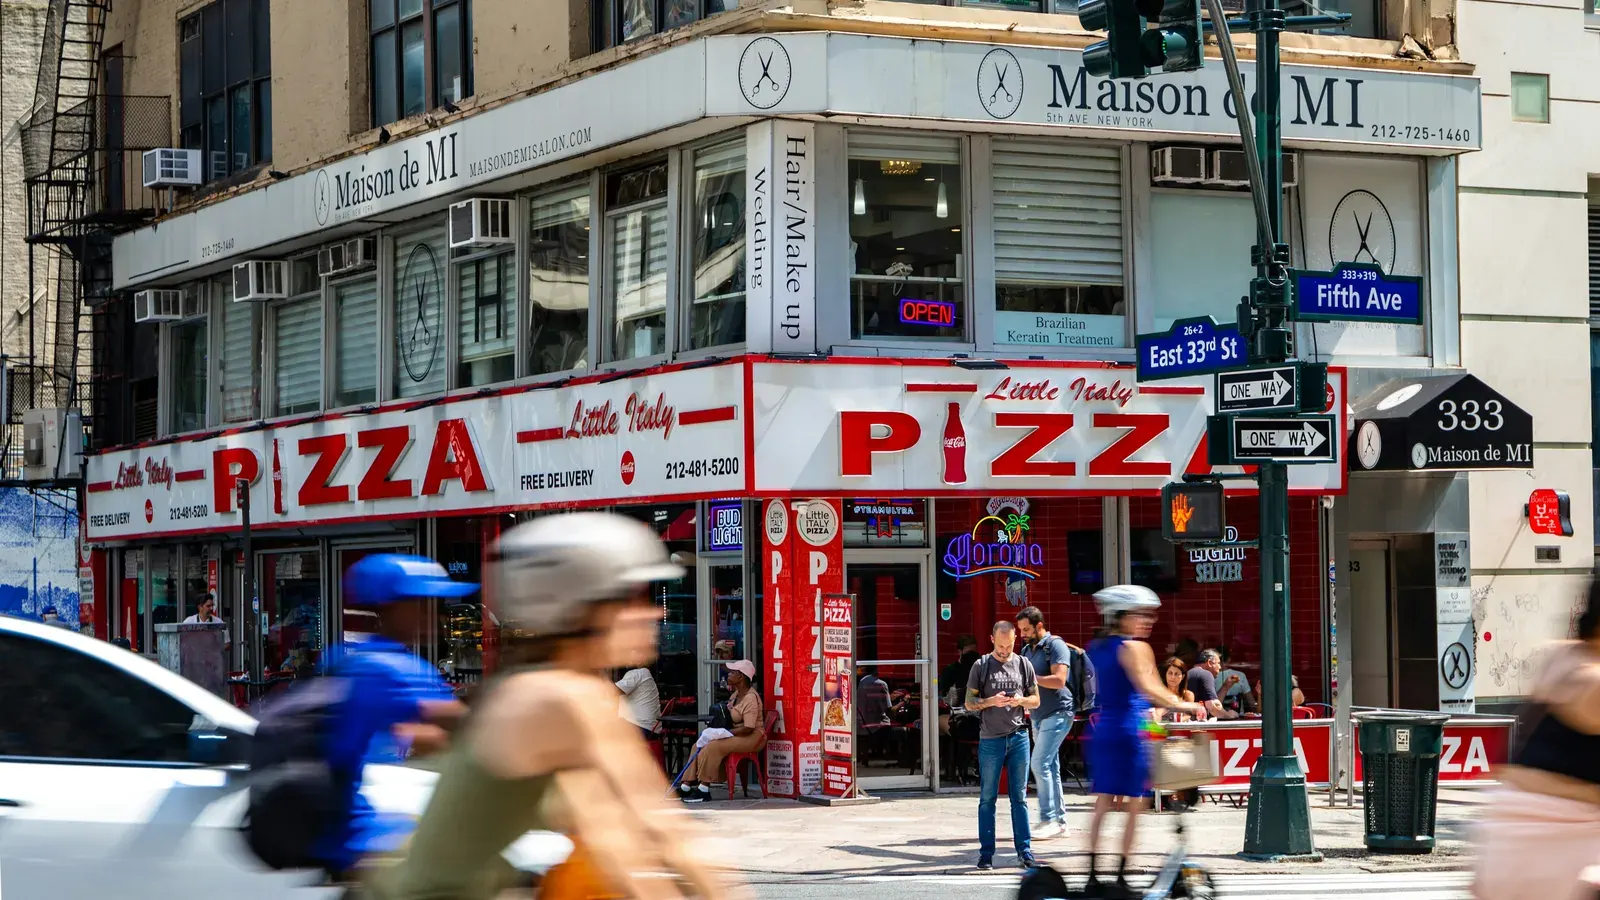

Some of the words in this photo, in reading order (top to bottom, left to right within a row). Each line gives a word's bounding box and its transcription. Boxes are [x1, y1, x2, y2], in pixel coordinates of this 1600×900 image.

[1047, 64, 1209, 116] Maison
[1223, 73, 1257, 119] d
[1290, 75, 1364, 128] MI
[1047, 112, 1063, 123] 5th
[1068, 114, 1088, 124] AVE
[1098, 115, 1120, 125] NEW
[1126, 117, 1153, 128] YORK
[1371, 124, 1470, 142] 212-725-1460
[470, 127, 592, 177] MAISONDEMISALON.COM
[335, 165, 394, 210] Maison
[400, 149, 419, 191] de
[426, 132, 458, 185] MI
[751, 166, 766, 289] Wedding
[1317, 283, 1360, 309] Fifth
[1366, 287, 1402, 311] Ave
[780, 302, 800, 339] up
[902, 301, 952, 323] OPEN
[1036, 316, 1086, 330] Brazilian
[1007, 330, 1049, 344] Keratin
[1056, 332, 1114, 346] Treatment
[1150, 345, 1182, 368] East
[1187, 336, 1216, 364] 33rd
[1221, 336, 1238, 360] St
[985, 376, 1058, 401] Little
[1070, 377, 1133, 408] Italy
[1230, 383, 1251, 399] ONE
[1261, 380, 1285, 397] WAY
[567, 399, 620, 440] Little
[625, 391, 676, 440] Italy
[1438, 400, 1504, 431] 333
[1250, 431, 1276, 446] ONE
[1288, 431, 1317, 446] WAY
[1428, 446, 1480, 463] Maison
[1484, 444, 1501, 461] de
[1506, 443, 1531, 462] MI
[115, 461, 144, 489] Little
[145, 456, 174, 490] Italy
[666, 457, 739, 480] 212-481-5200
[521, 474, 544, 490] FREE
[548, 470, 594, 488] DELIVERY
[90, 515, 104, 527] FREE
[105, 512, 130, 526] DELIVERY
[170, 504, 208, 520] 212-481-5200
[717, 509, 740, 528] BUD
[806, 510, 829, 520] Little
[853, 505, 914, 515] #TEAMULTRA
[1534, 503, 1549, 527] 본
[806, 520, 829, 528] ITALY
[713, 527, 742, 545] LIGHT
[944, 533, 1043, 581] Corona
[1196, 562, 1242, 583] SELTZER
[1439, 567, 1466, 575] STUDIO
[824, 608, 851, 622] PIZZA
